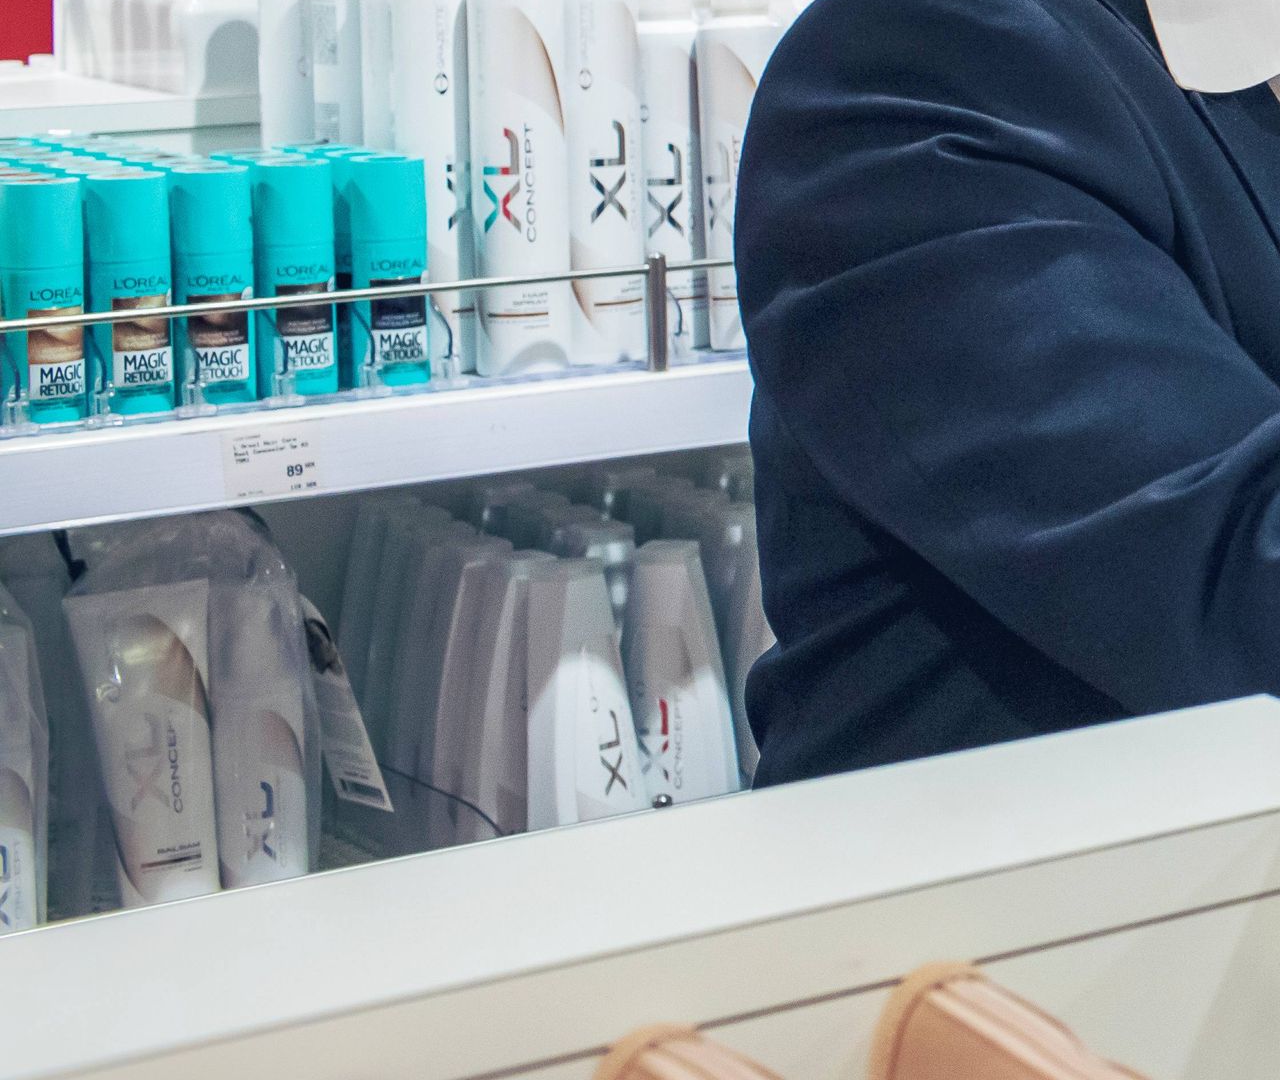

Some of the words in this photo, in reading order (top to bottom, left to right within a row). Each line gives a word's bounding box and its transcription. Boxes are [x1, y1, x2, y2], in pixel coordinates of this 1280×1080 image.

[483, 127, 521, 233] XL
[590, 120, 627, 224] XL
[524, 123, 537, 243] CONCEPT
[647, 143, 684, 238] XL
[287, 336, 328, 355] MAGIC
[380, 331, 422, 349] MAGIC
[124, 350, 167, 371] MAGIC
[199, 349, 242, 366] MAGIC
[40, 363, 82, 384] MAGIC
[287, 464, 304, 477] 89
[599, 710, 628, 796] XL
